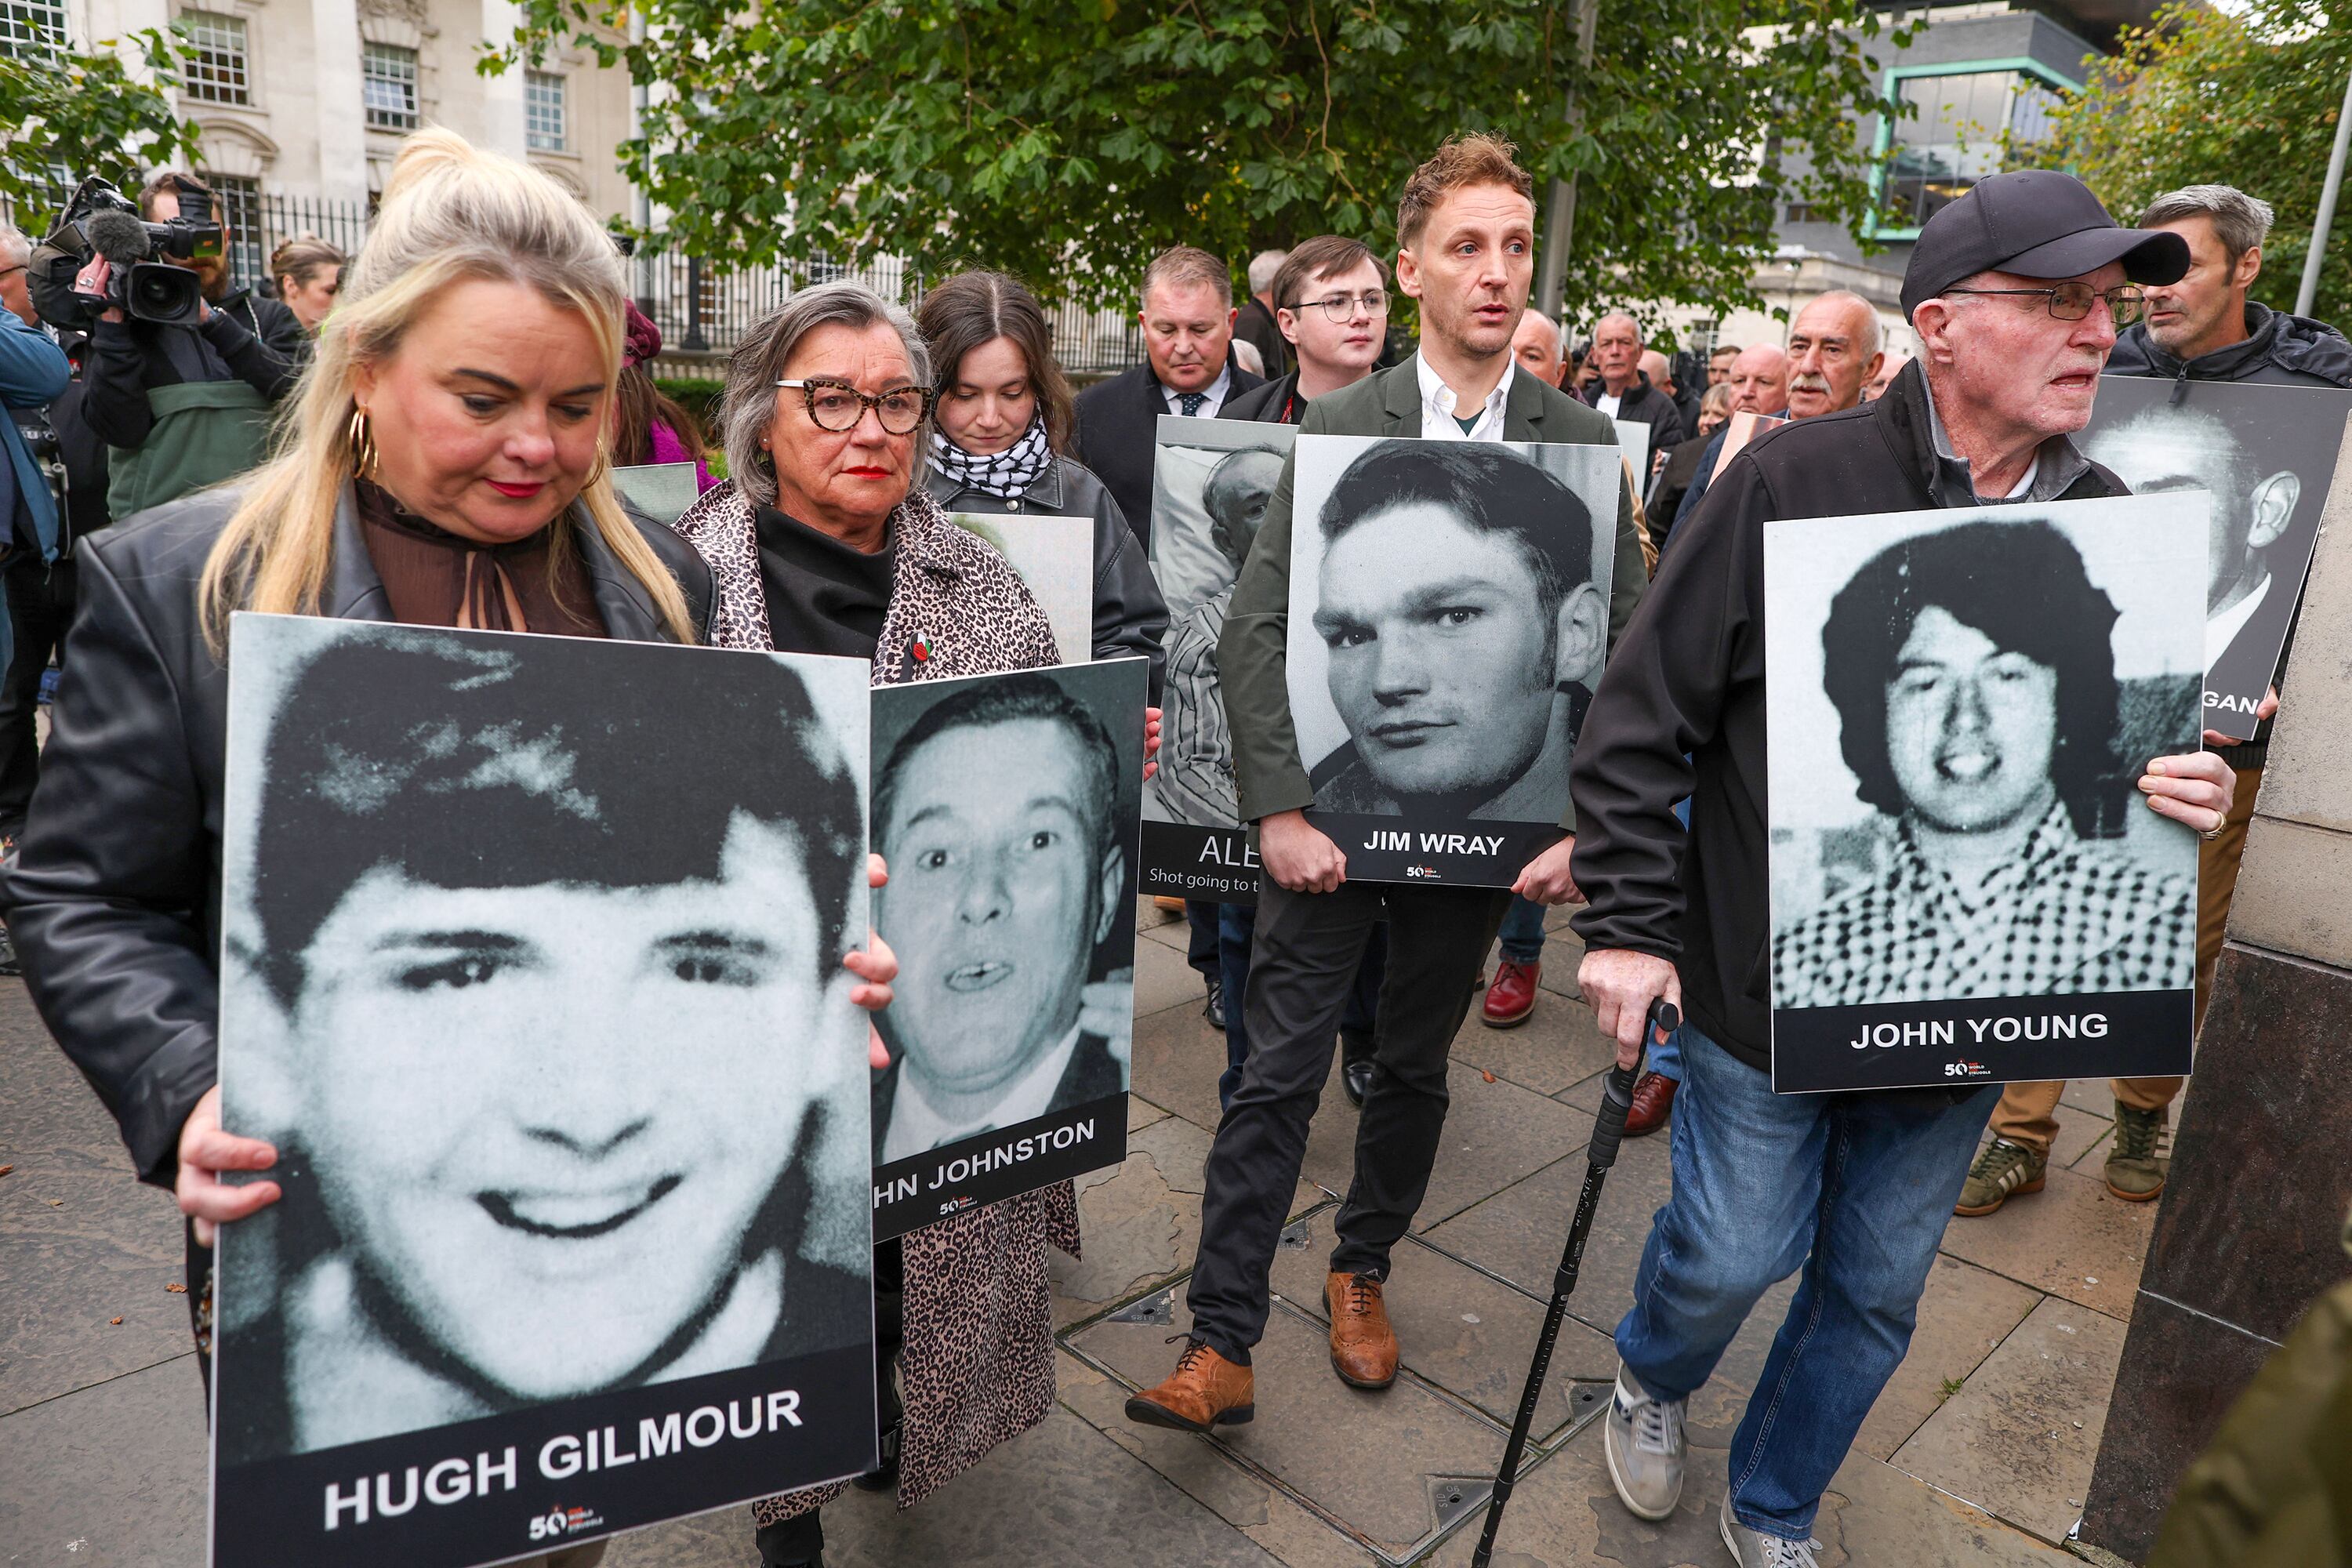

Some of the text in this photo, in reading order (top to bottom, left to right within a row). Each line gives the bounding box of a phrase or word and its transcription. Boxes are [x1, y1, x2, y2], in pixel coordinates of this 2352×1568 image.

[1363, 830, 1505, 856] JIM WRAY
[1149, 868, 1183, 884] Shot
[1187, 874, 1229, 892] going
[1234, 878, 1249, 891] to
[1850, 1013, 2108, 1050] JOHN YOUNG
[1944, 1063, 1968, 1076] 50
[928, 1118, 1094, 1190] JOHNSTON
[324, 1388, 804, 1531] HUGH GILMOUR
